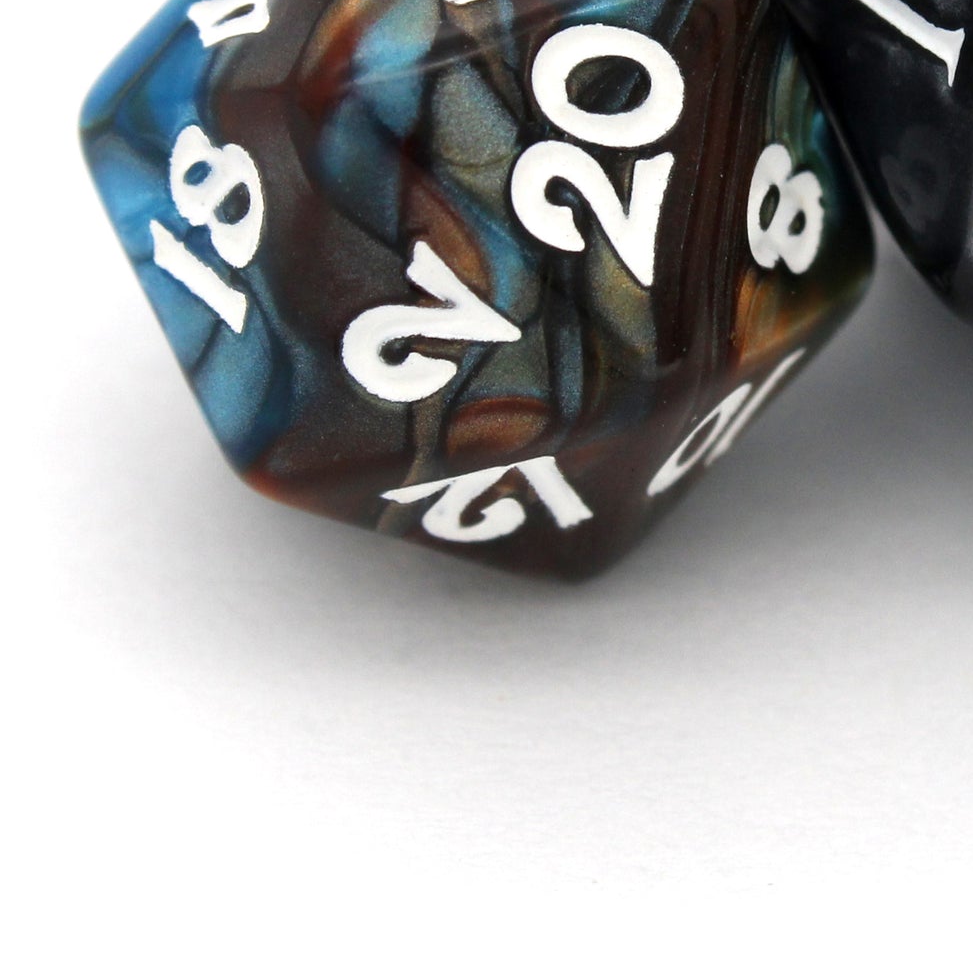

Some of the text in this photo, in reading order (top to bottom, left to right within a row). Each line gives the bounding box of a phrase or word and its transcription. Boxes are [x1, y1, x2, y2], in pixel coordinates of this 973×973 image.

[147, 123, 265, 335] 18
[510, 22, 685, 287] 20
[745, 142, 825, 274] 8
[340, 239, 523, 404] 2
[380, 454, 594, 543] 12
